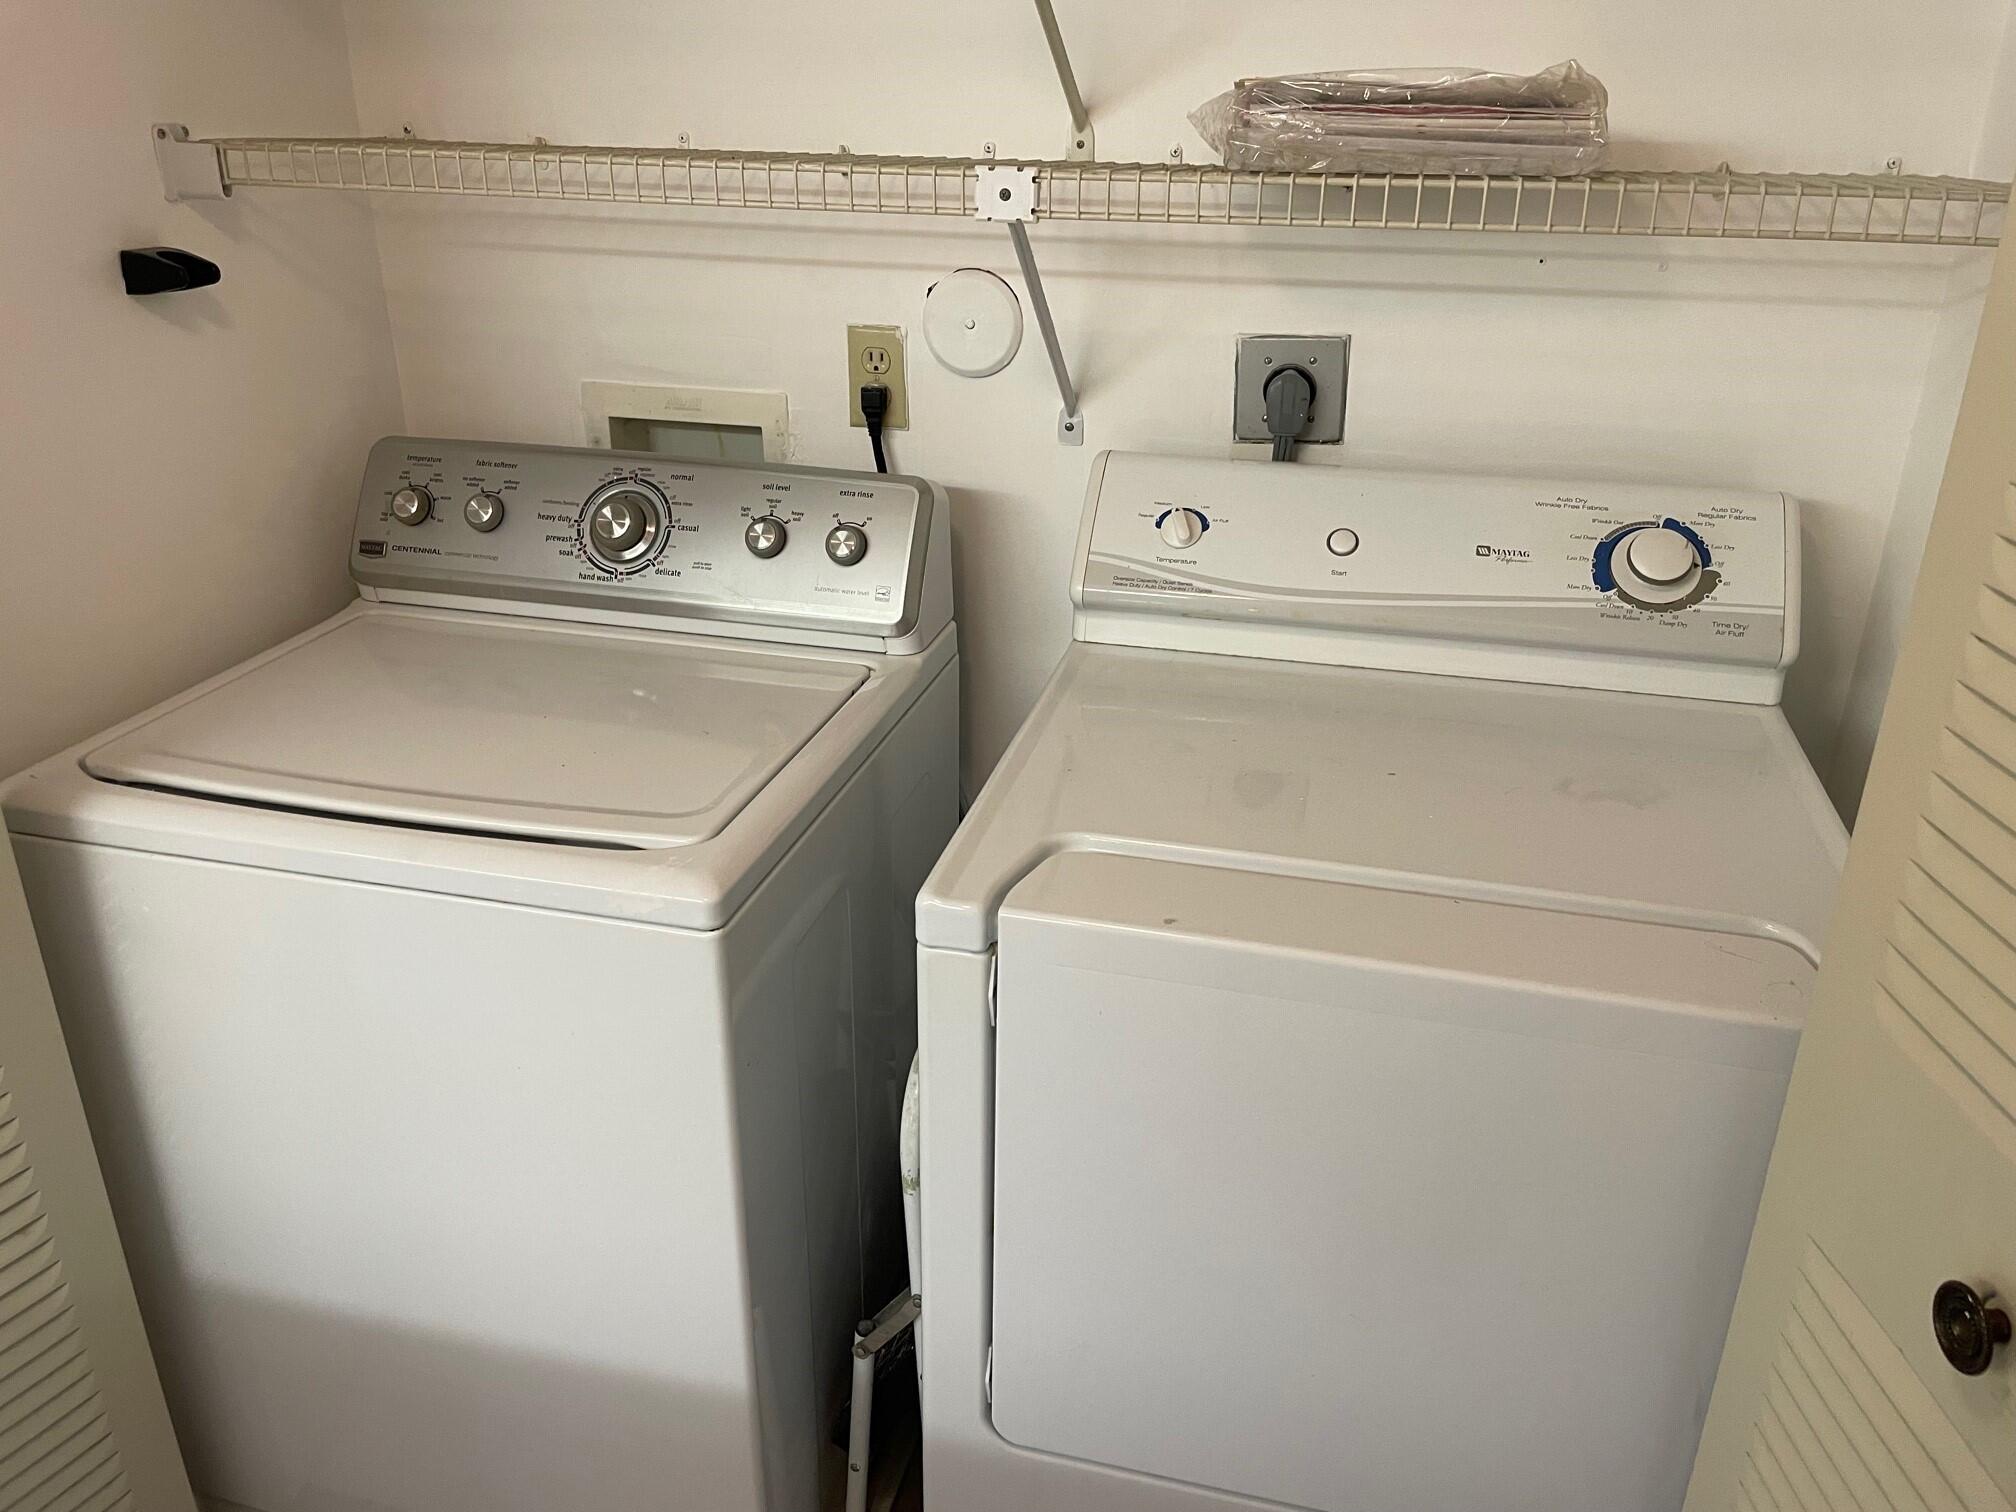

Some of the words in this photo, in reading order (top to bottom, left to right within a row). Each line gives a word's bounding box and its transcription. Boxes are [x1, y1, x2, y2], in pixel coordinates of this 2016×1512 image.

[407, 454, 442, 463] temperature
[476, 459, 492, 467] fabric
[494, 461, 518, 469] softener
[776, 484, 791, 492] level
[857, 490, 874, 498] rinse
[1582, 504, 1608, 512] Fabrics
[538, 512, 556, 522] heavy
[558, 514, 572, 522] duty
[678, 524, 699, 532] casual
[392, 545, 442, 555] CENTENNIAL
[1492, 548, 1530, 558] MAYTAG
[1156, 556, 1197, 565] Temperature
[578, 572, 595, 580] hand
[597, 574, 613, 582] wash
[655, 568, 681, 577] delicate
[1331, 569, 1347, 577] Start
[1733, 623, 1750, 631] Dry/
